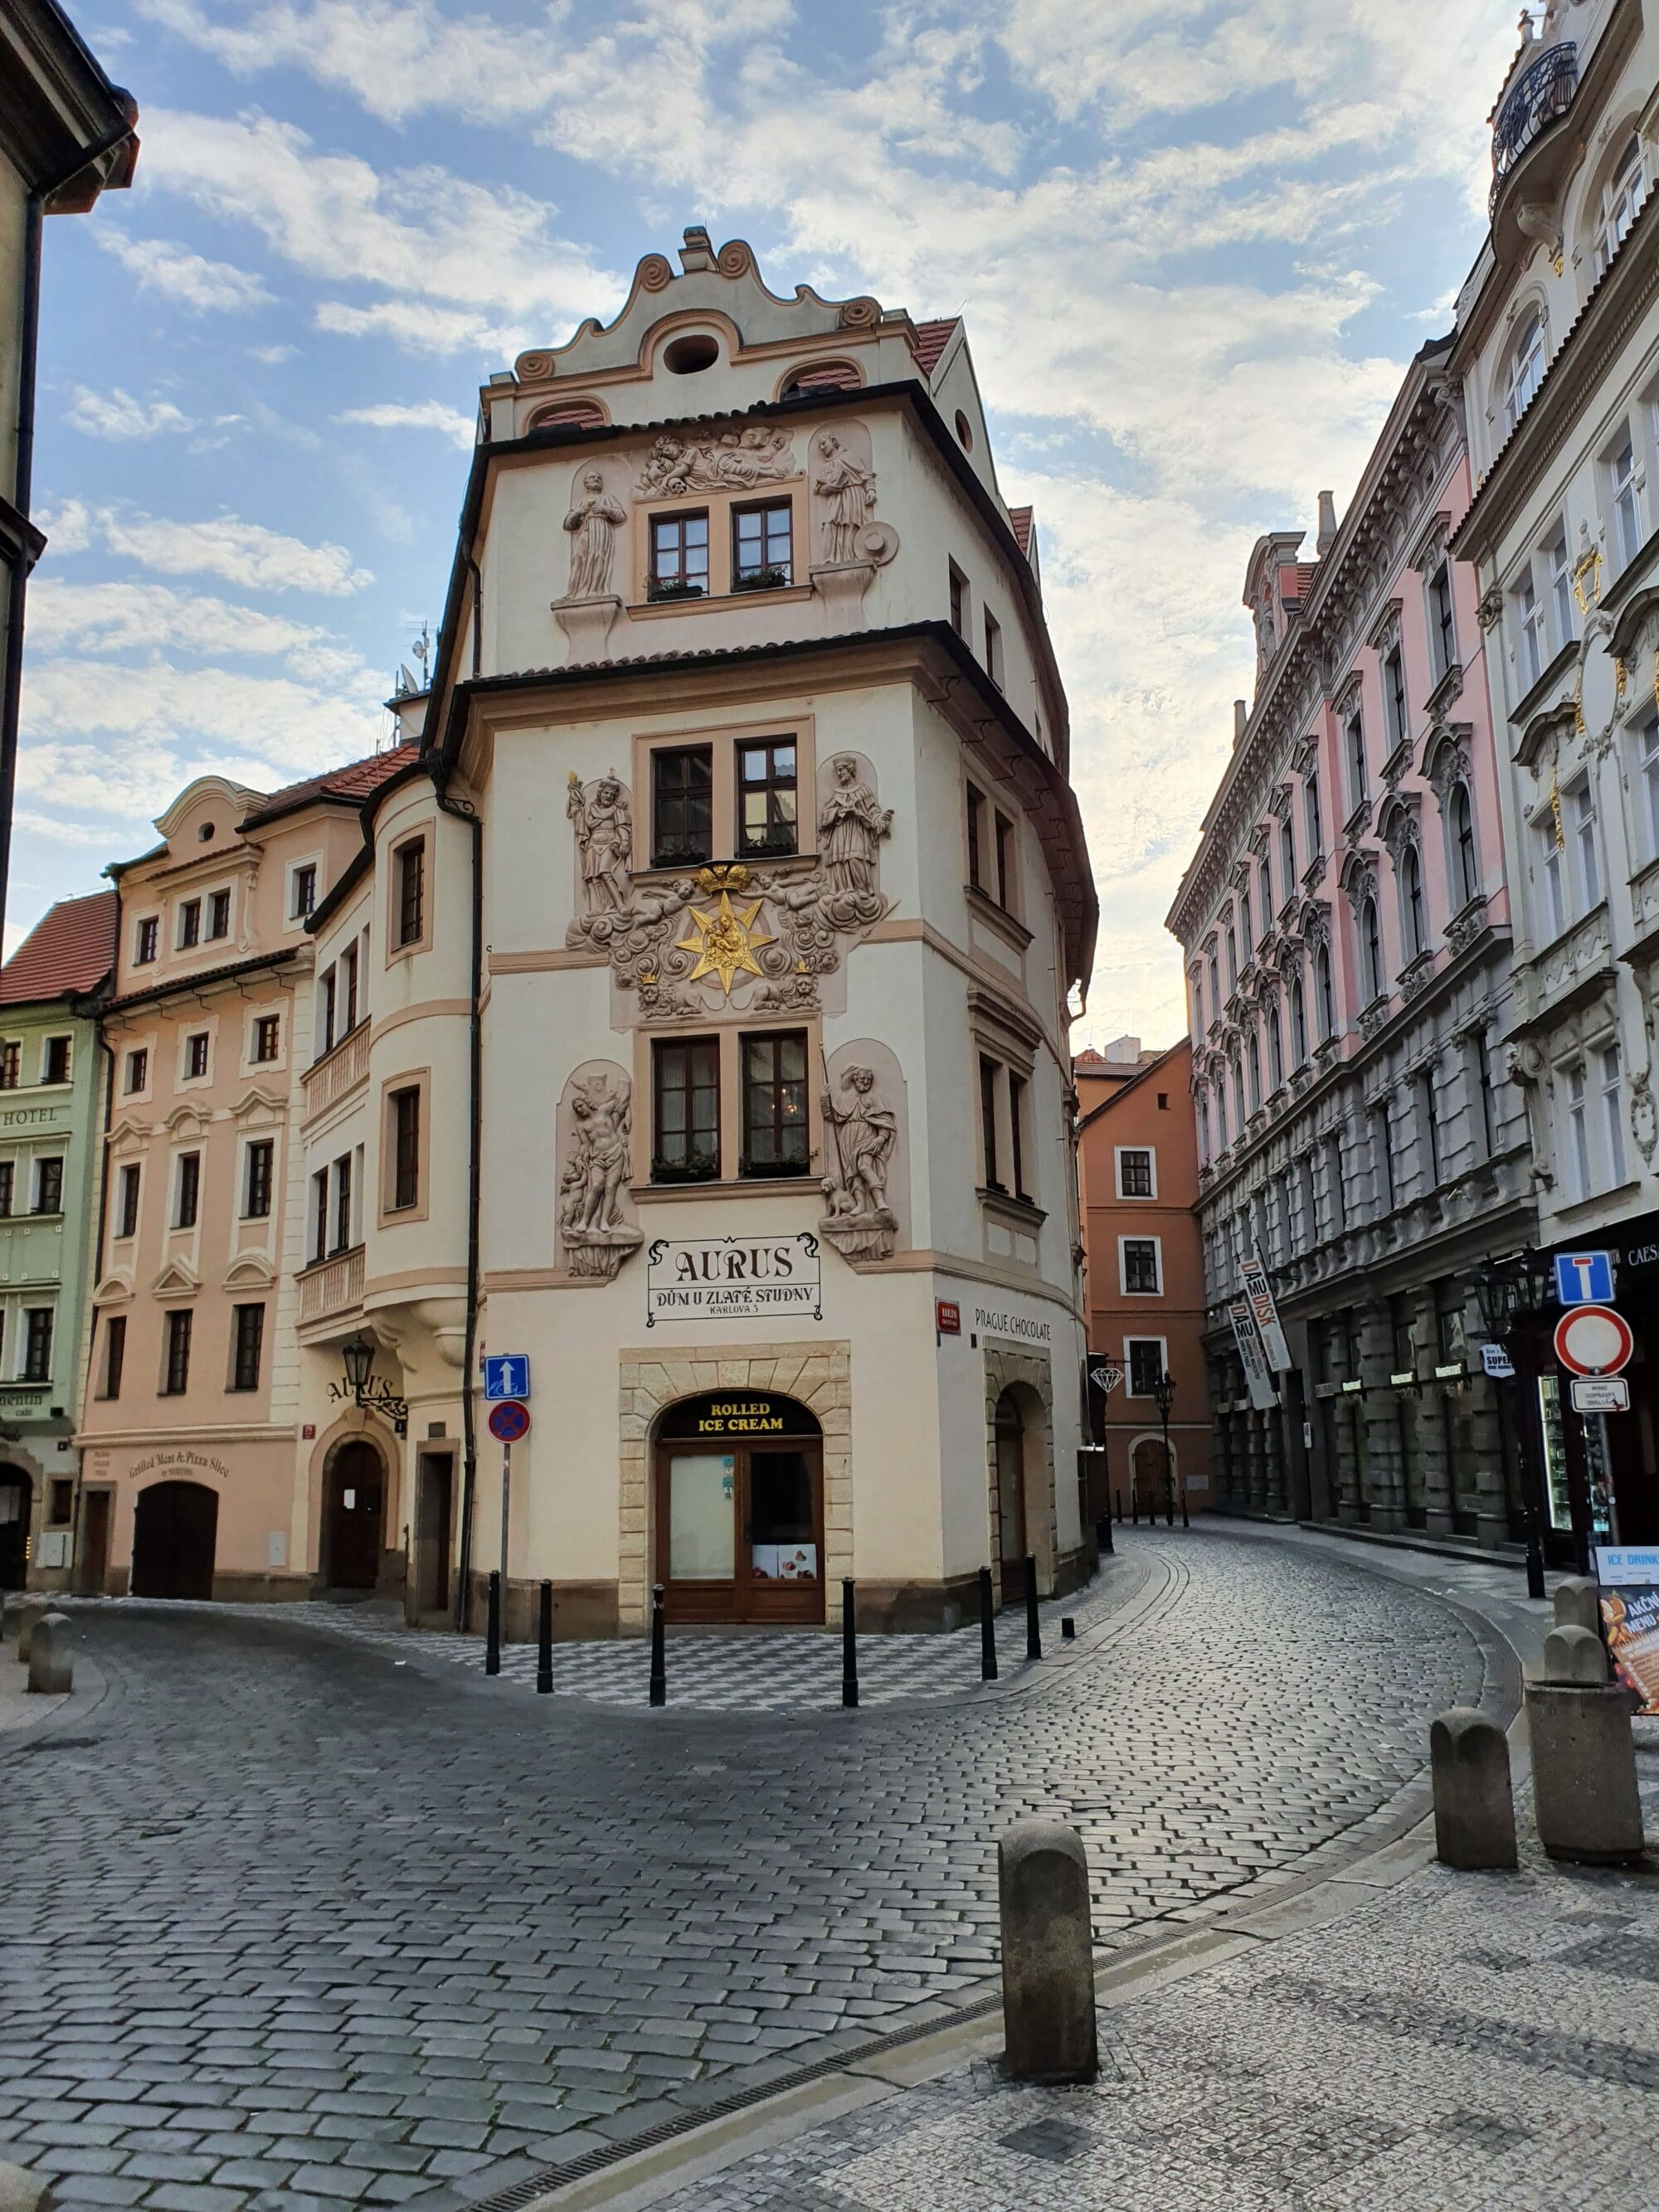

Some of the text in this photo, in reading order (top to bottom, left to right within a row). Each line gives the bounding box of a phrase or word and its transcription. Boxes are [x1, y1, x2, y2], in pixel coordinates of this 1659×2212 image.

[4, 1108, 57, 1125] HOTEL
[675, 1247, 793, 1281] AURUS
[1628, 1243, 1659, 1266] CAES
[657, 1287, 814, 1306] DŮM U ZLATÉ STUDNY
[710, 1305, 751, 1315] KARLOVA
[975, 1308, 1052, 1341] PRAGUE CHOCOLATE
[711, 1403, 771, 1416] ROLLED
[698, 1417, 783, 1432] ICE CREAM
[129, 1456, 155, 1479] Grilled
[176, 1451, 186, 1463] &
[186, 1451, 207, 1466] Pizza
[1608, 1553, 1659, 1566] ICE DRINK
[1625, 1613, 1657, 1634] MENU
